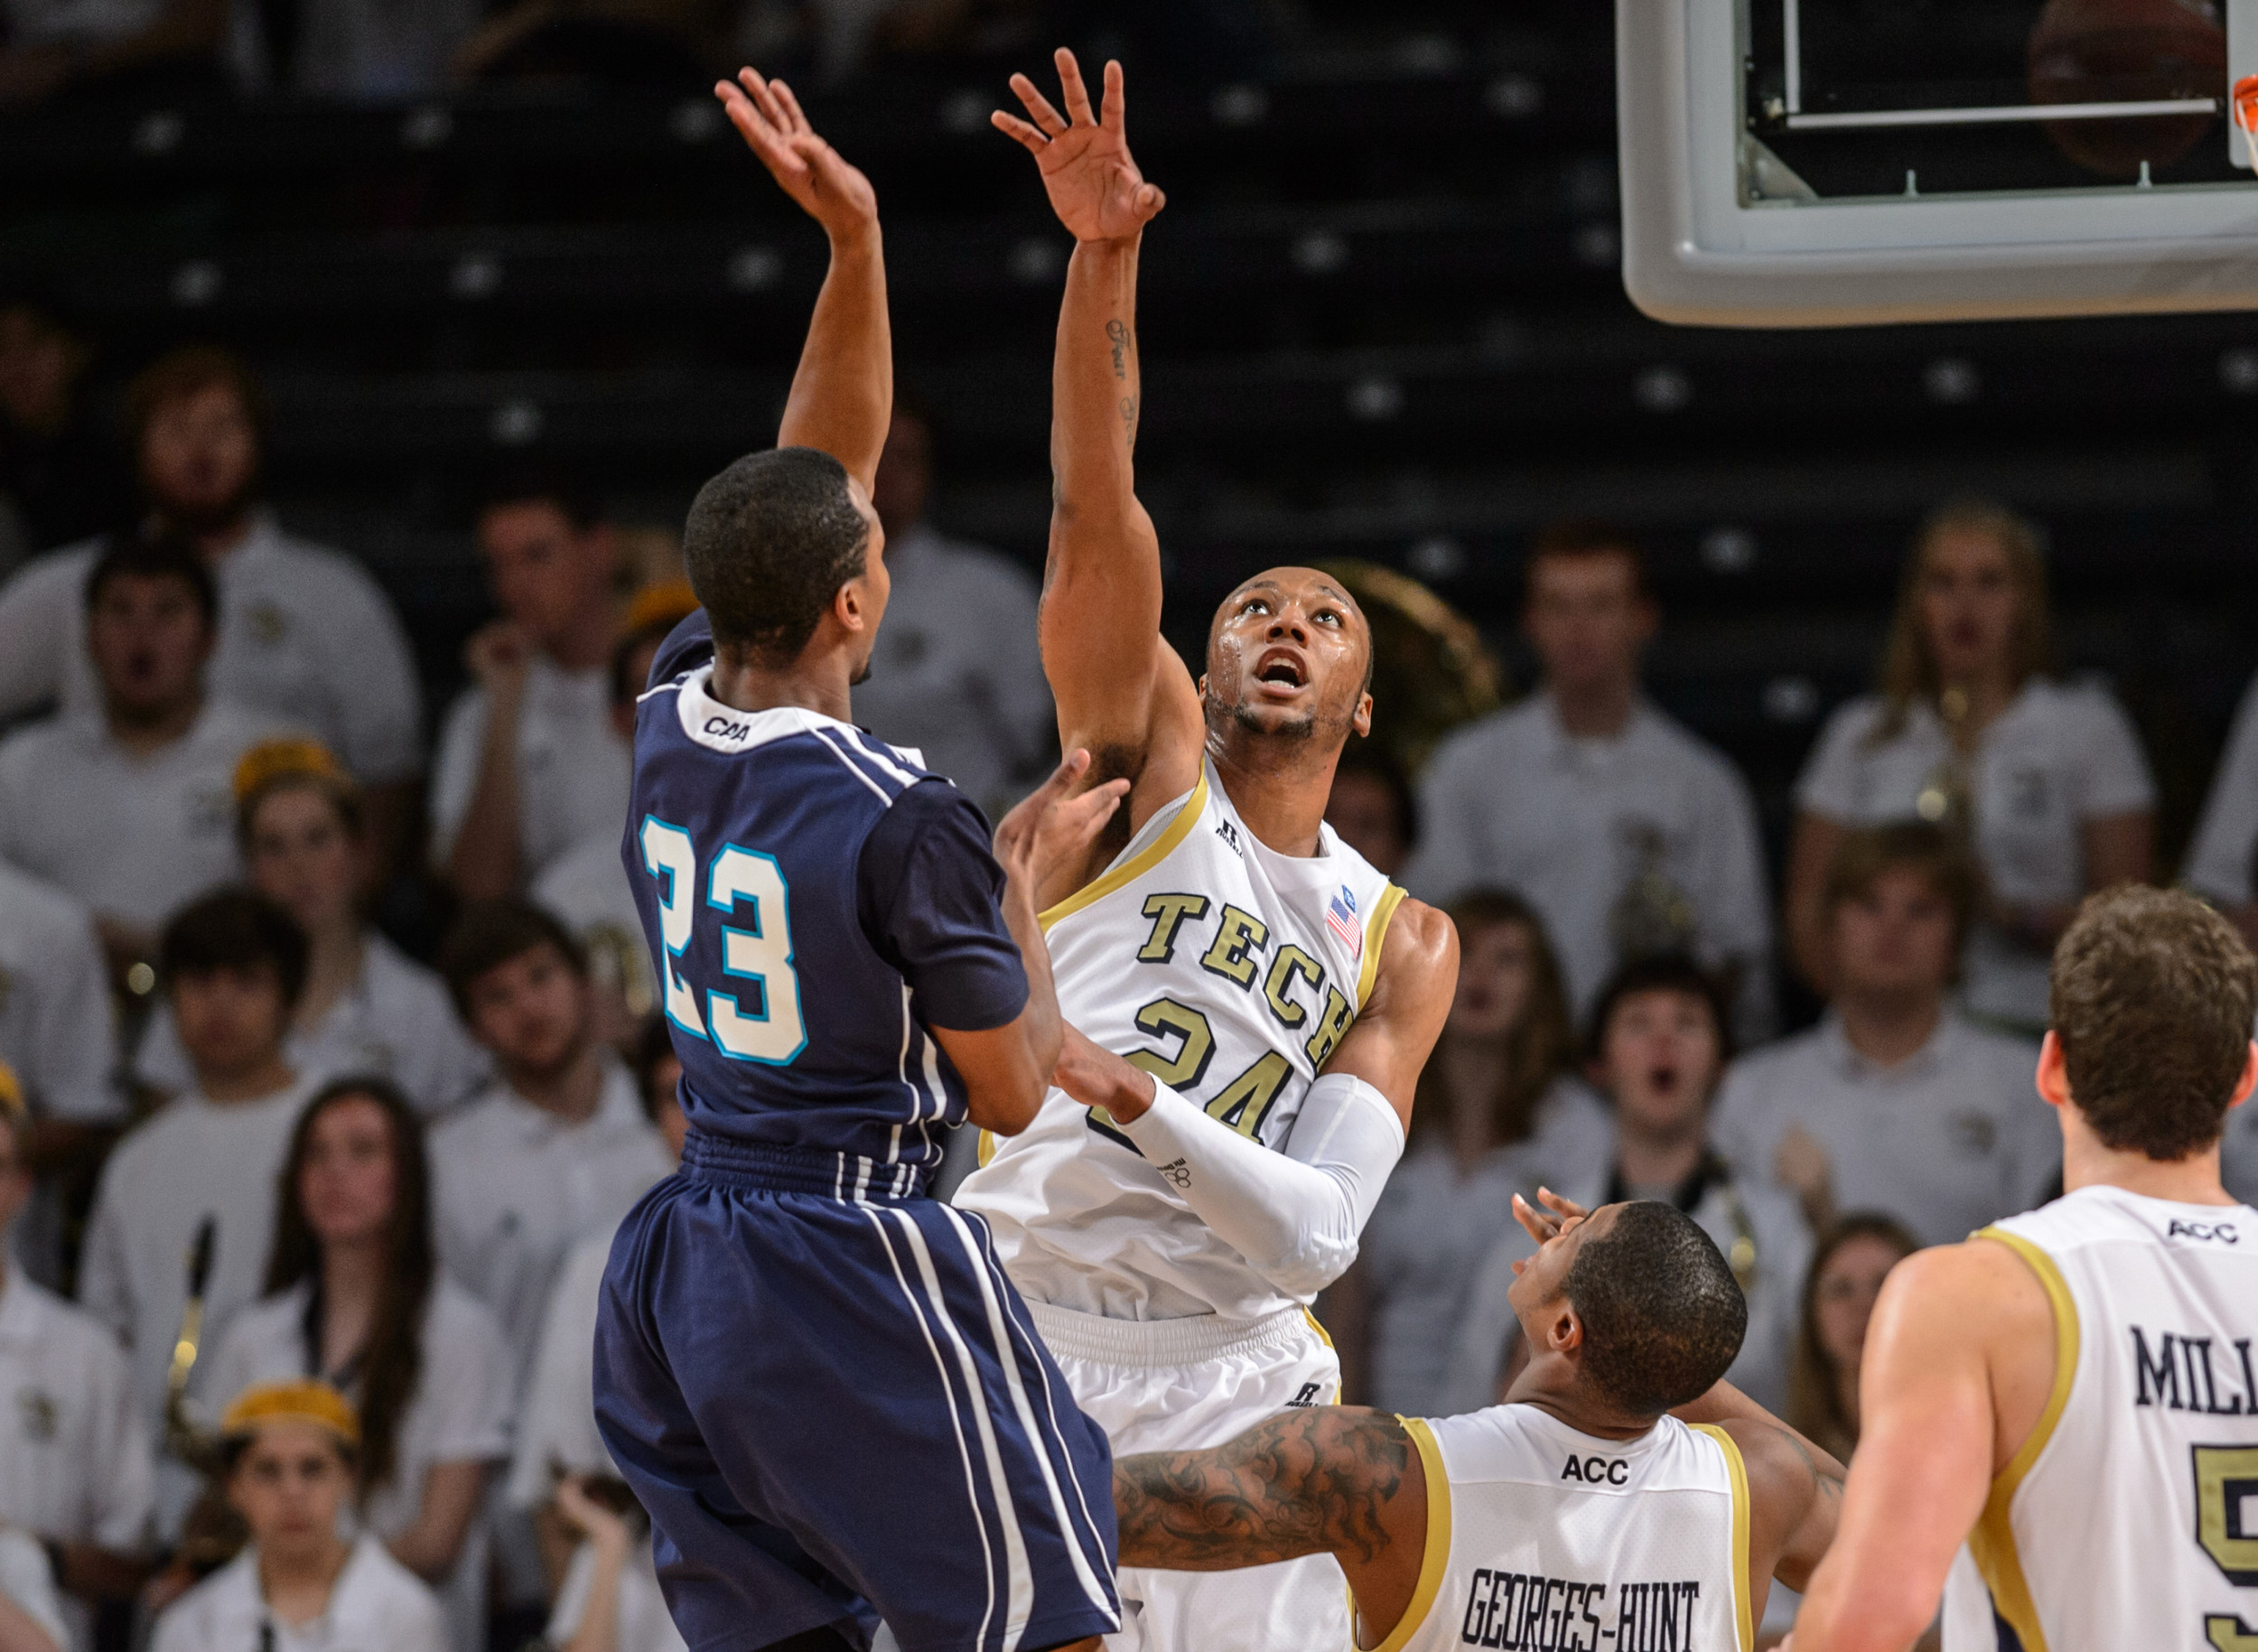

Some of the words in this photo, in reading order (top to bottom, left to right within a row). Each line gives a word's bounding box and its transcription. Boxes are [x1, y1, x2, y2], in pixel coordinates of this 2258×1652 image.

[704, 716, 751, 742] CAA
[639, 813, 809, 1067] 23
[1137, 892, 1354, 1078] TECH
[1086, 997, 1295, 1158] 24
[2169, 1218, 2239, 1244] ACC
[1561, 1453, 1629, 1486] ACC
[1461, 1567, 1700, 1652] GEORGES-HUNT
